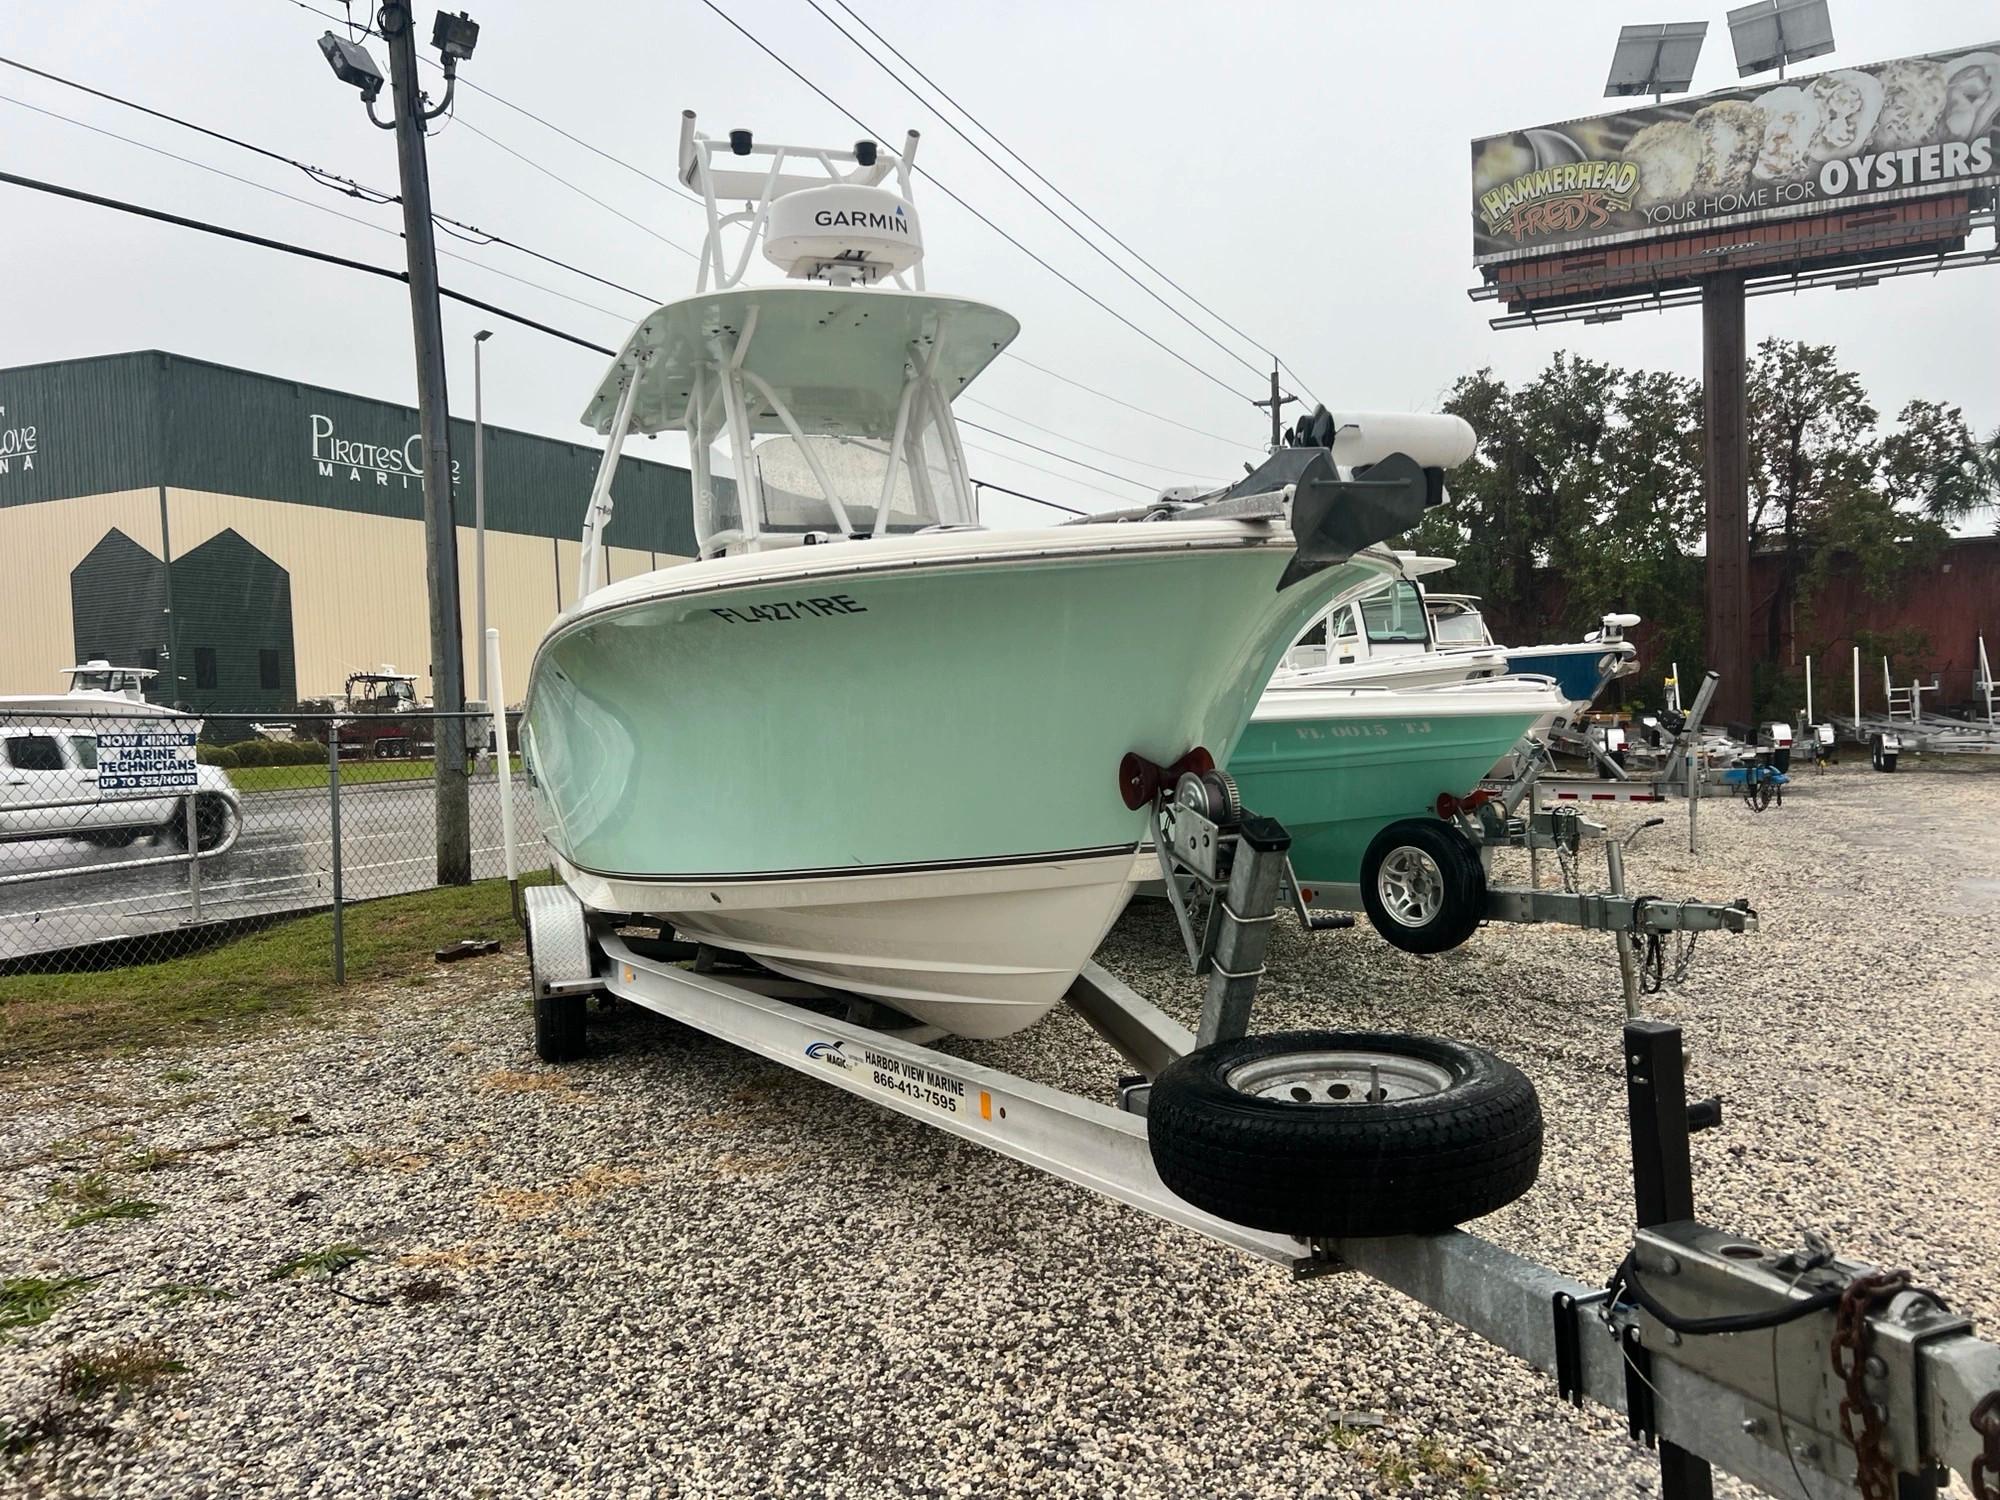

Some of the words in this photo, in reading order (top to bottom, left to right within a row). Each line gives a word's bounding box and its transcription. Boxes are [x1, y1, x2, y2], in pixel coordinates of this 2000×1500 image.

[1820, 137, 1992, 195] OYSTERS
[1482, 162, 1639, 220] HAMMERHEAD
[1644, 200, 1697, 224] YOUR
[1704, 191, 1768, 215] HOME
[1776, 181, 1815, 202] FOR
[815, 210, 908, 234] GARMIN
[1512, 191, 1609, 242] FRED'S
[710, 594, 868, 624] FL4271RE
[101, 735, 138, 747] NOW
[142, 734, 189, 746] HIRING
[121, 749, 176, 760] MARINE
[99, 760, 196, 773] TECHNICIANS
[101, 778, 117, 787] UP
[120, 777, 137, 786] TO
[865, 1050, 900, 1075] HARBOR
[901, 1063, 925, 1083] VIEW
[926, 1071, 965, 1097] MARINE
[873, 1070, 956, 1112] 866-413-7595
